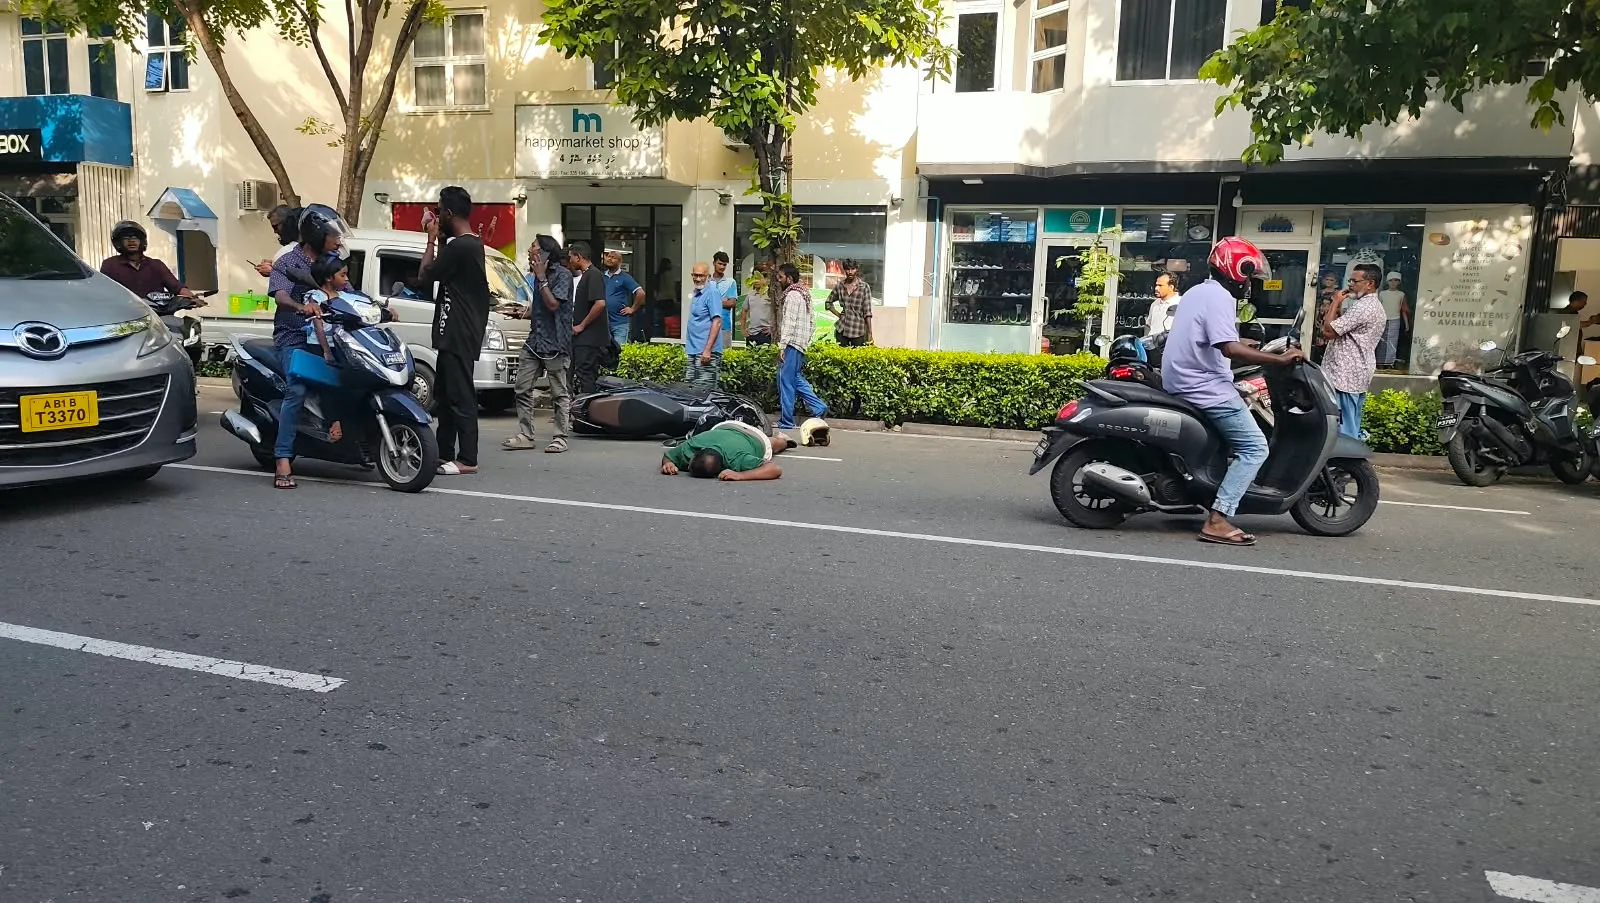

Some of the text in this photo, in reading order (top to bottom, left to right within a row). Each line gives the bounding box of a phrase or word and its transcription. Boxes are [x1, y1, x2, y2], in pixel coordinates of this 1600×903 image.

[0, 134, 30, 153] BOX
[525, 135, 651, 150] happymarket shop 4
[1423, 311, 1510, 320] SOUVENIR ITEMS
[1437, 319, 1494, 327] AVAILABLE
[35, 408, 86, 425] T3370
